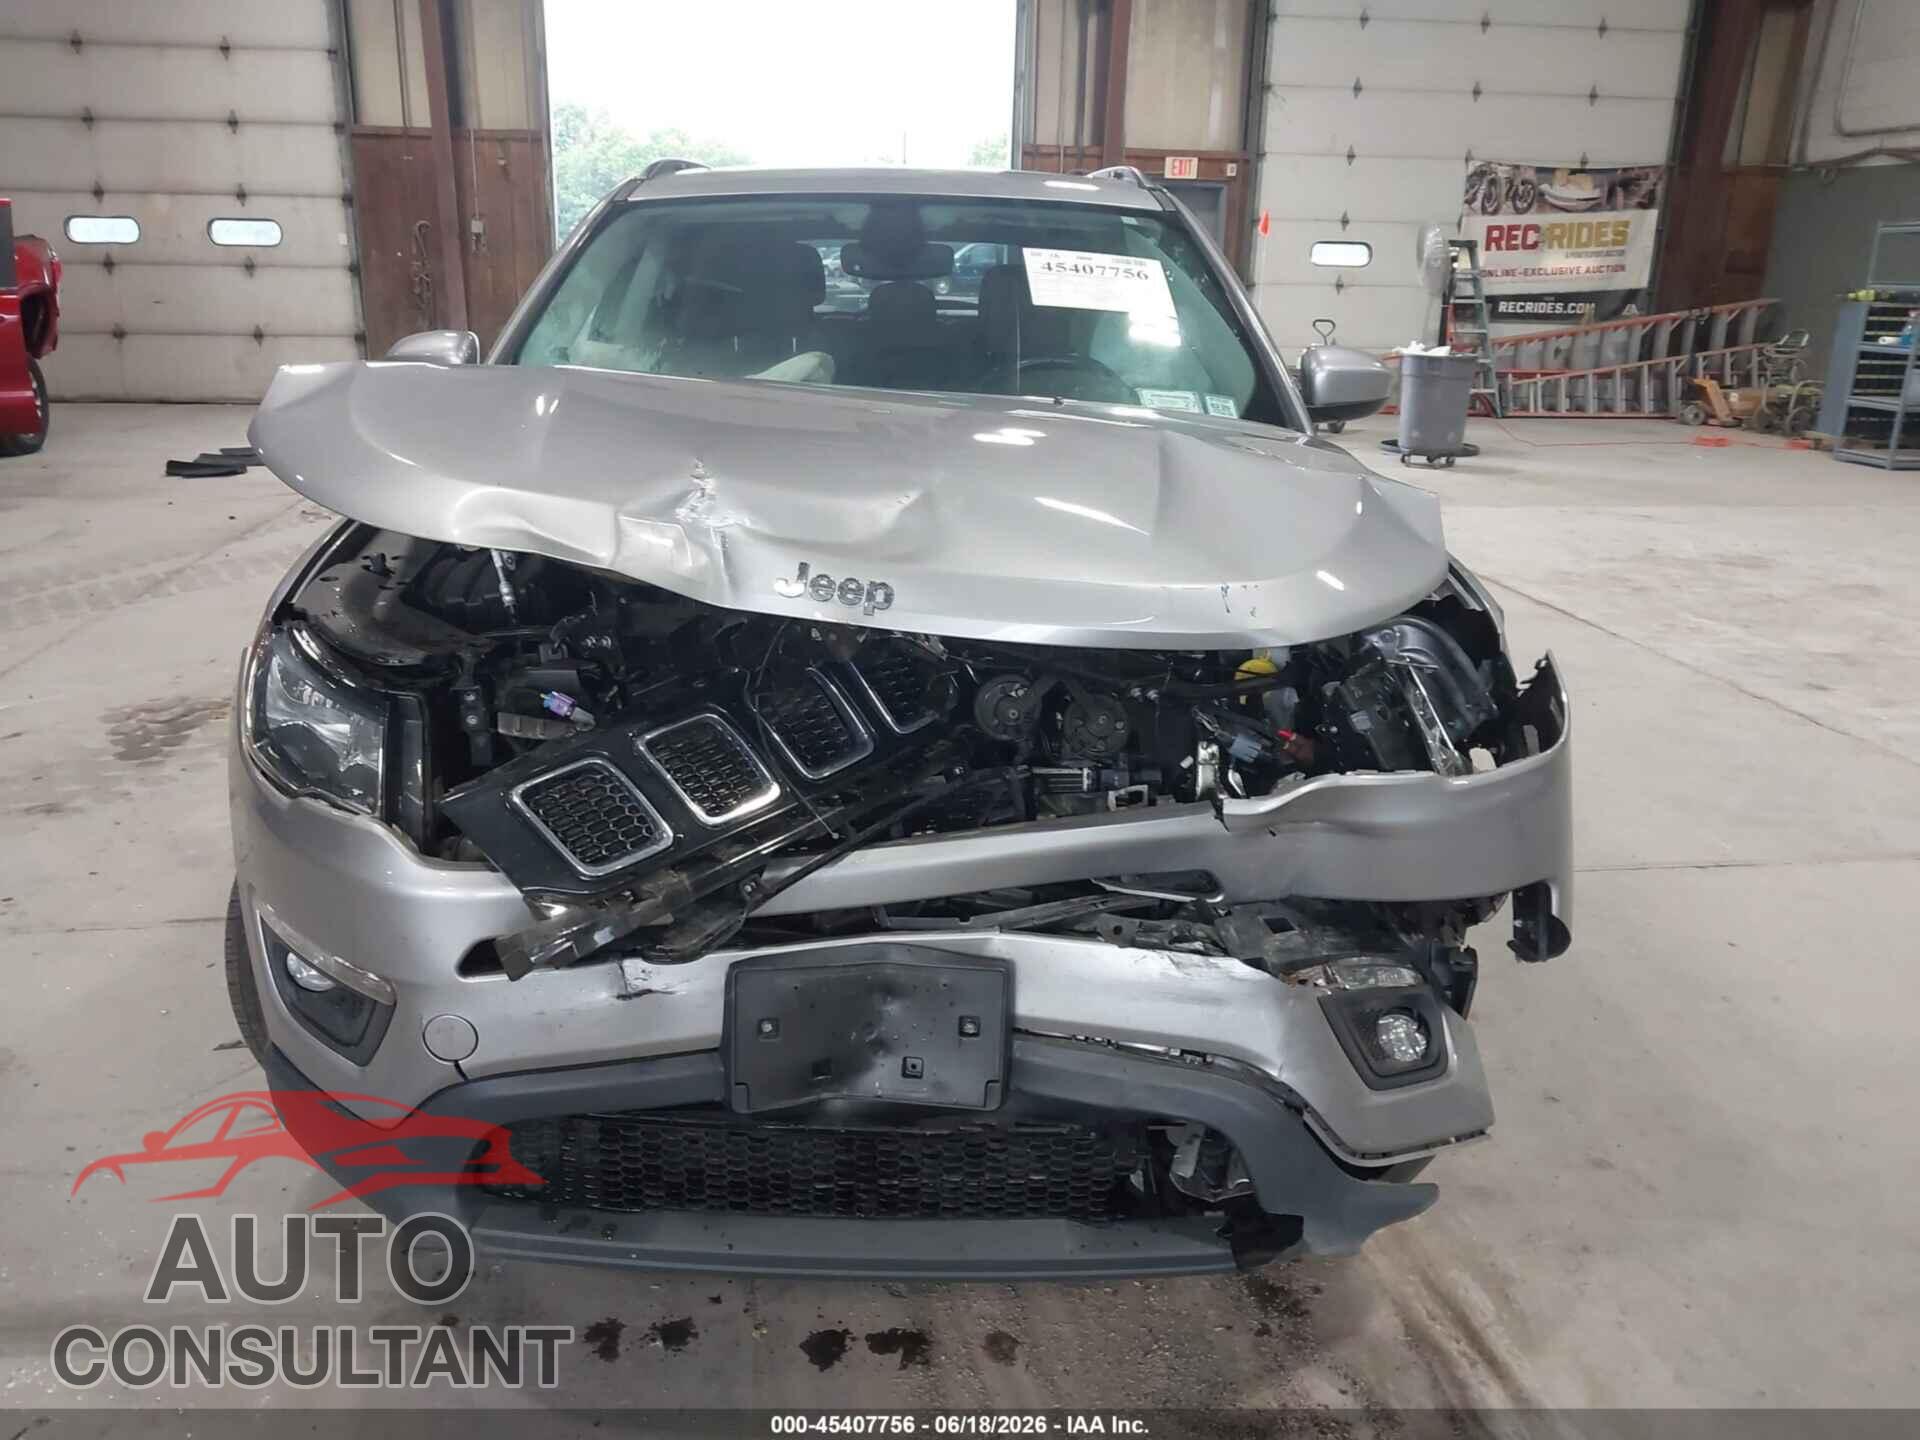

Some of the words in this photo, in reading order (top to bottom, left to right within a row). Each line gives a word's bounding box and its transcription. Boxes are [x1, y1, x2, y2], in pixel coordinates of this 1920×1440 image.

[1485, 224, 1540, 251] REC
[1547, 221, 1630, 248] RIDES
[1042, 261, 1149, 280] 45407756
[1586, 264, 1626, 273] AUCTION
[1498, 301, 1596, 314] RECRIDES.COM
[773, 562, 895, 616] Jeep
